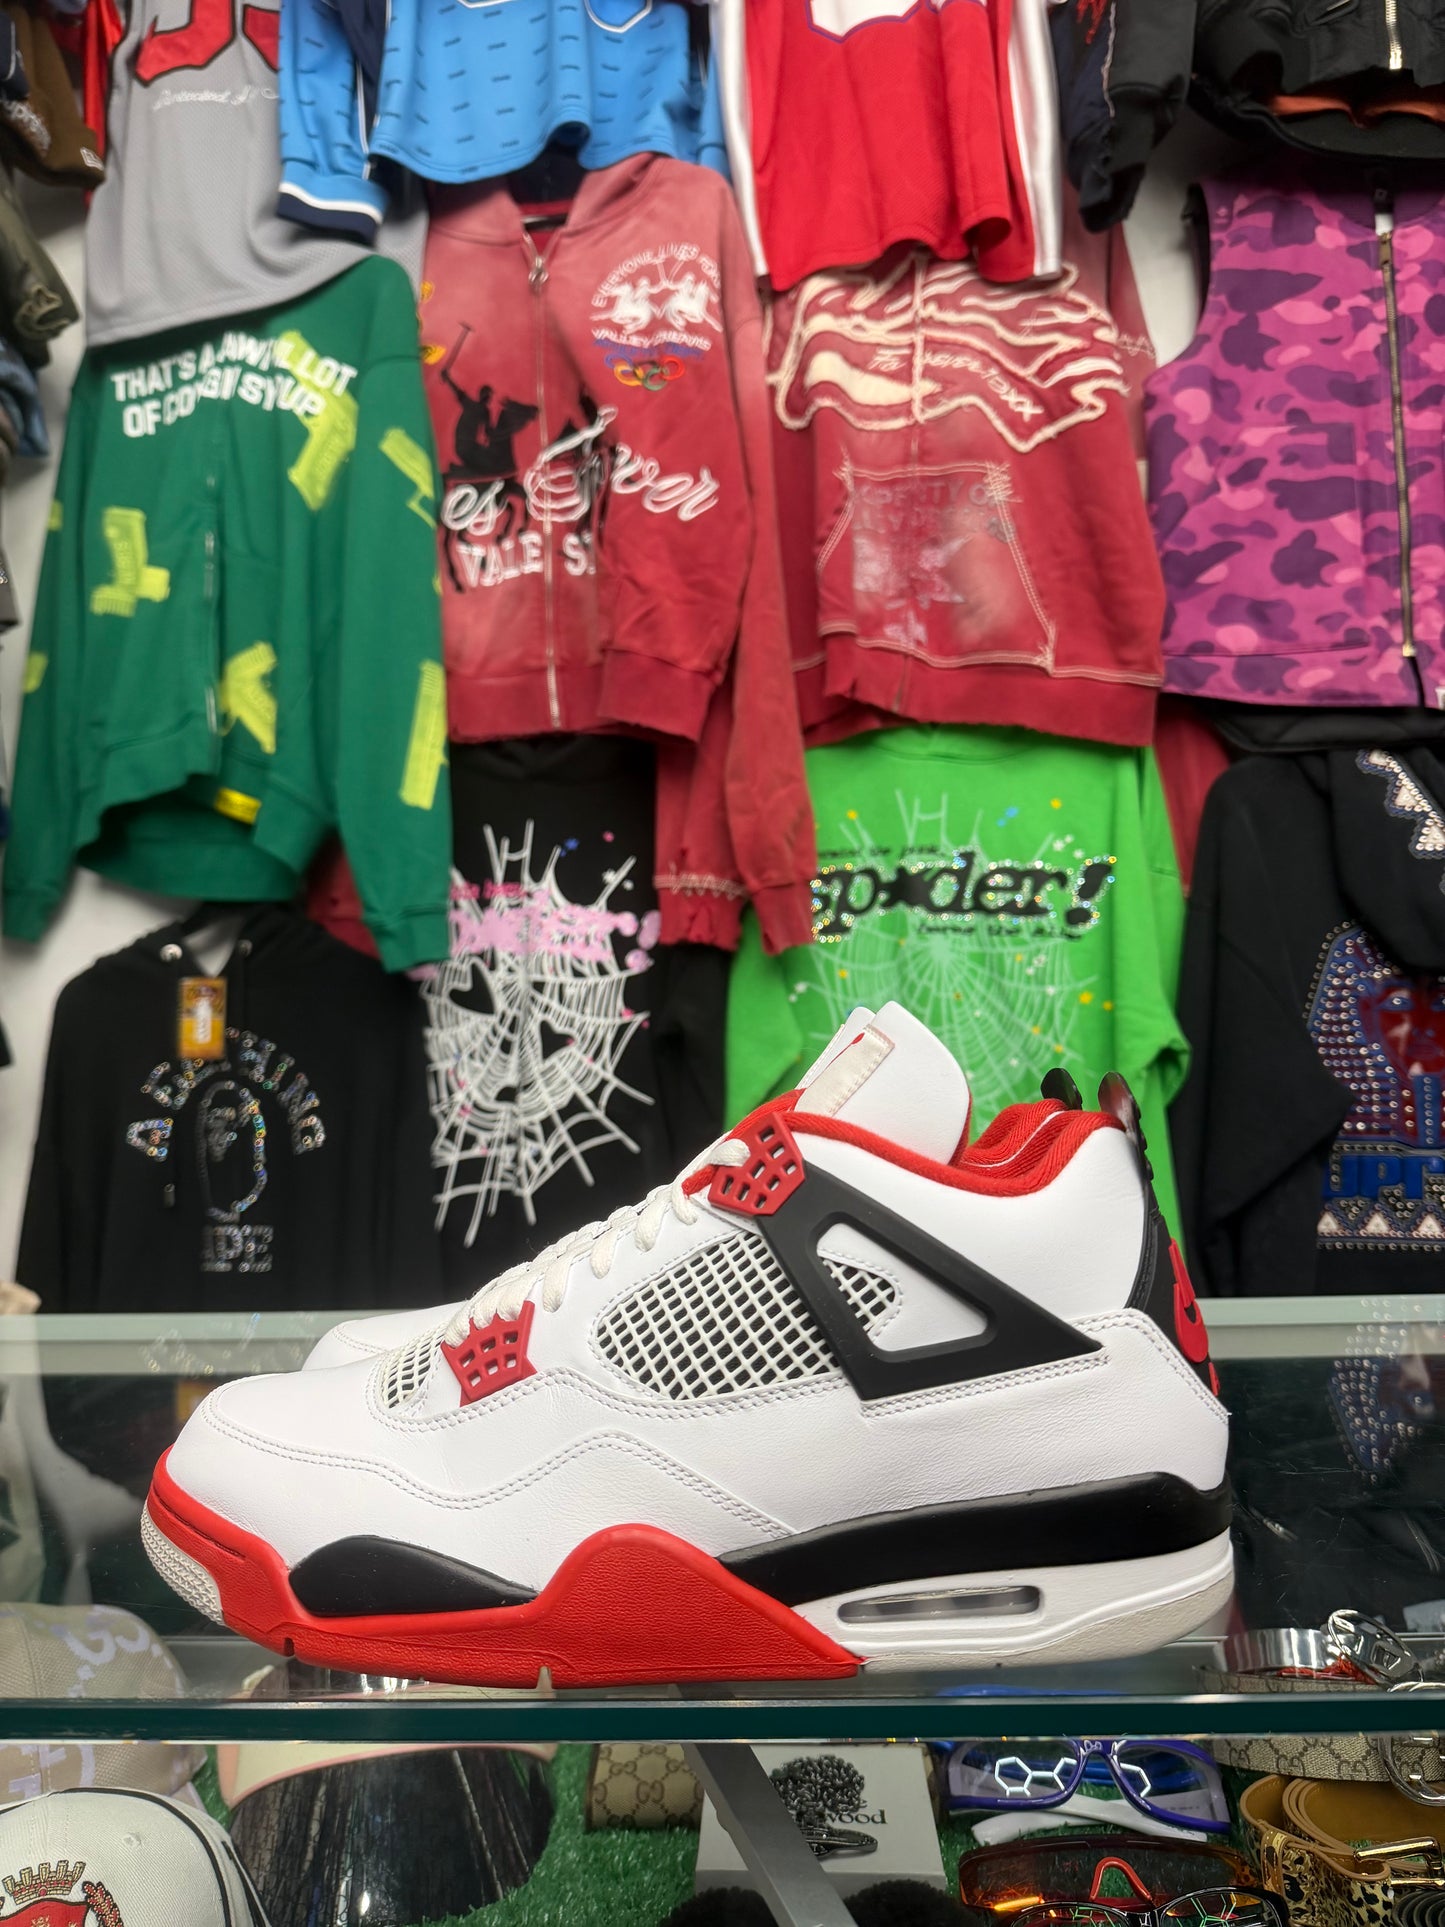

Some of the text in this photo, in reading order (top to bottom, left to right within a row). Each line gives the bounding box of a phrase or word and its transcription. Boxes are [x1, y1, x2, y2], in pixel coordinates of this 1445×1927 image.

[111, 351, 197, 402] THAT'S
[296, 351, 358, 397] LOT
[123, 399, 162, 437] OF
[237, 371, 327, 417] SYUP
